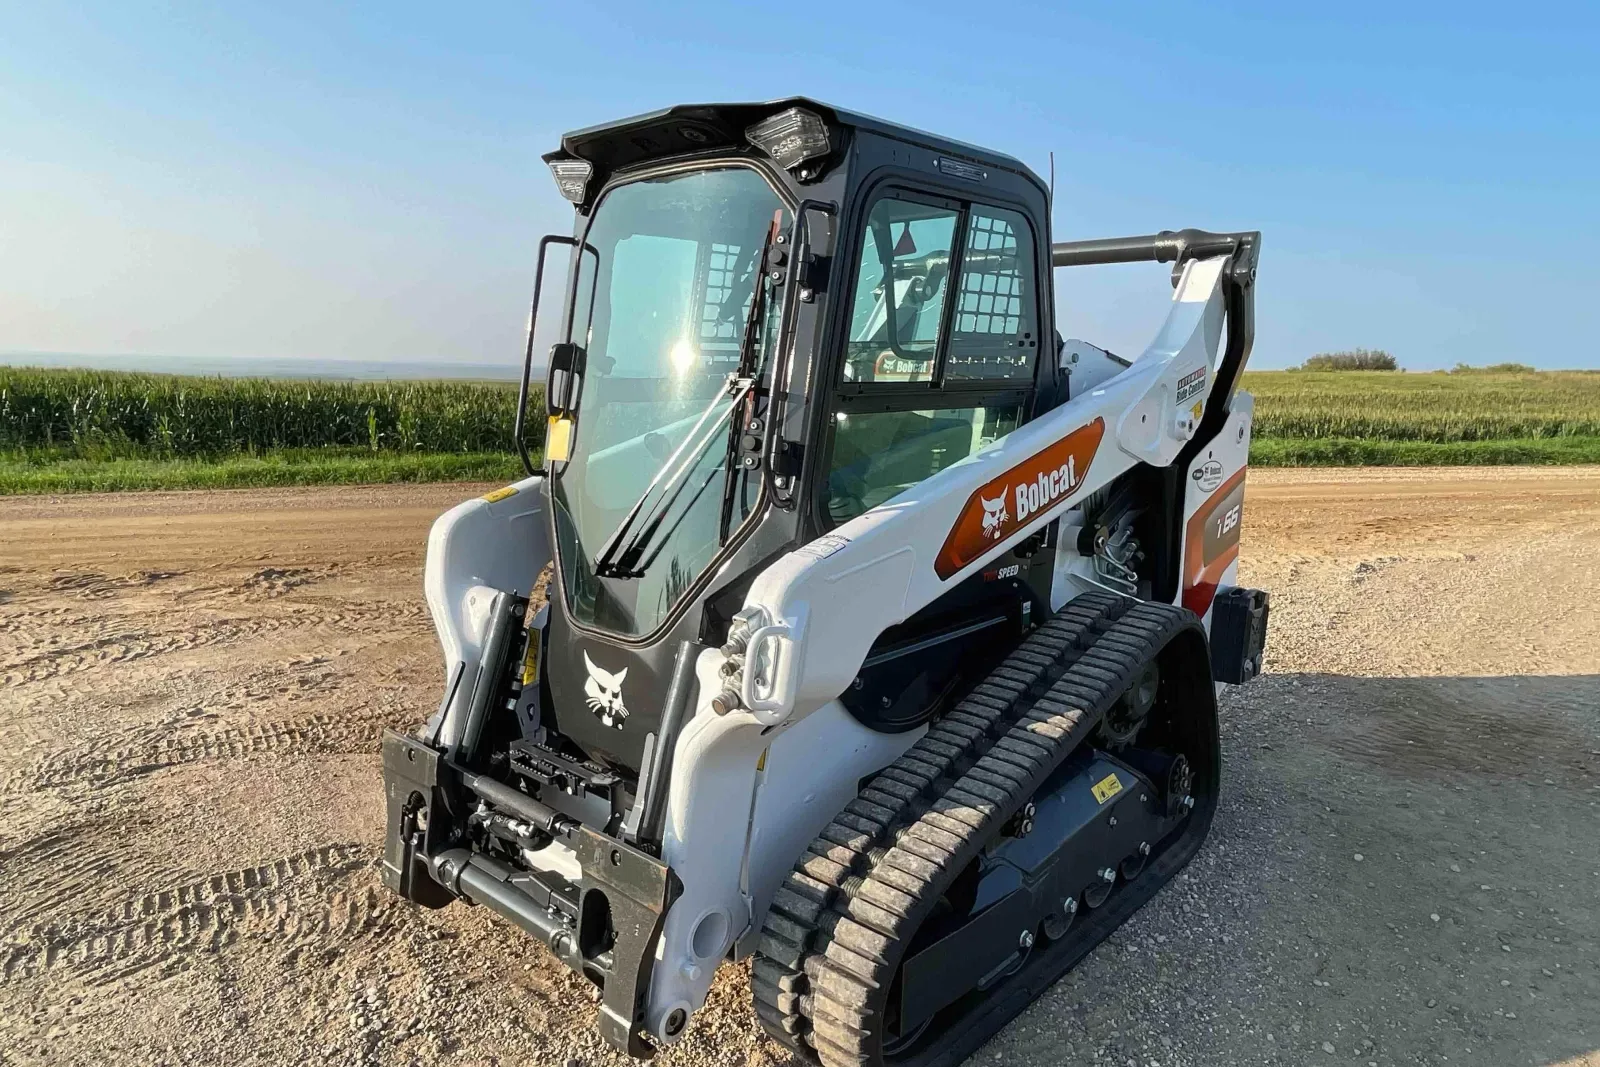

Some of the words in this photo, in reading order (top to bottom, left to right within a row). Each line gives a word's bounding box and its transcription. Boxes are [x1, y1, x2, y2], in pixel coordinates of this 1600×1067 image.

[896, 360, 928, 373] Bobcat
[1015, 453, 1075, 522] Bobcat
[997, 564, 1019, 580] SPEED
